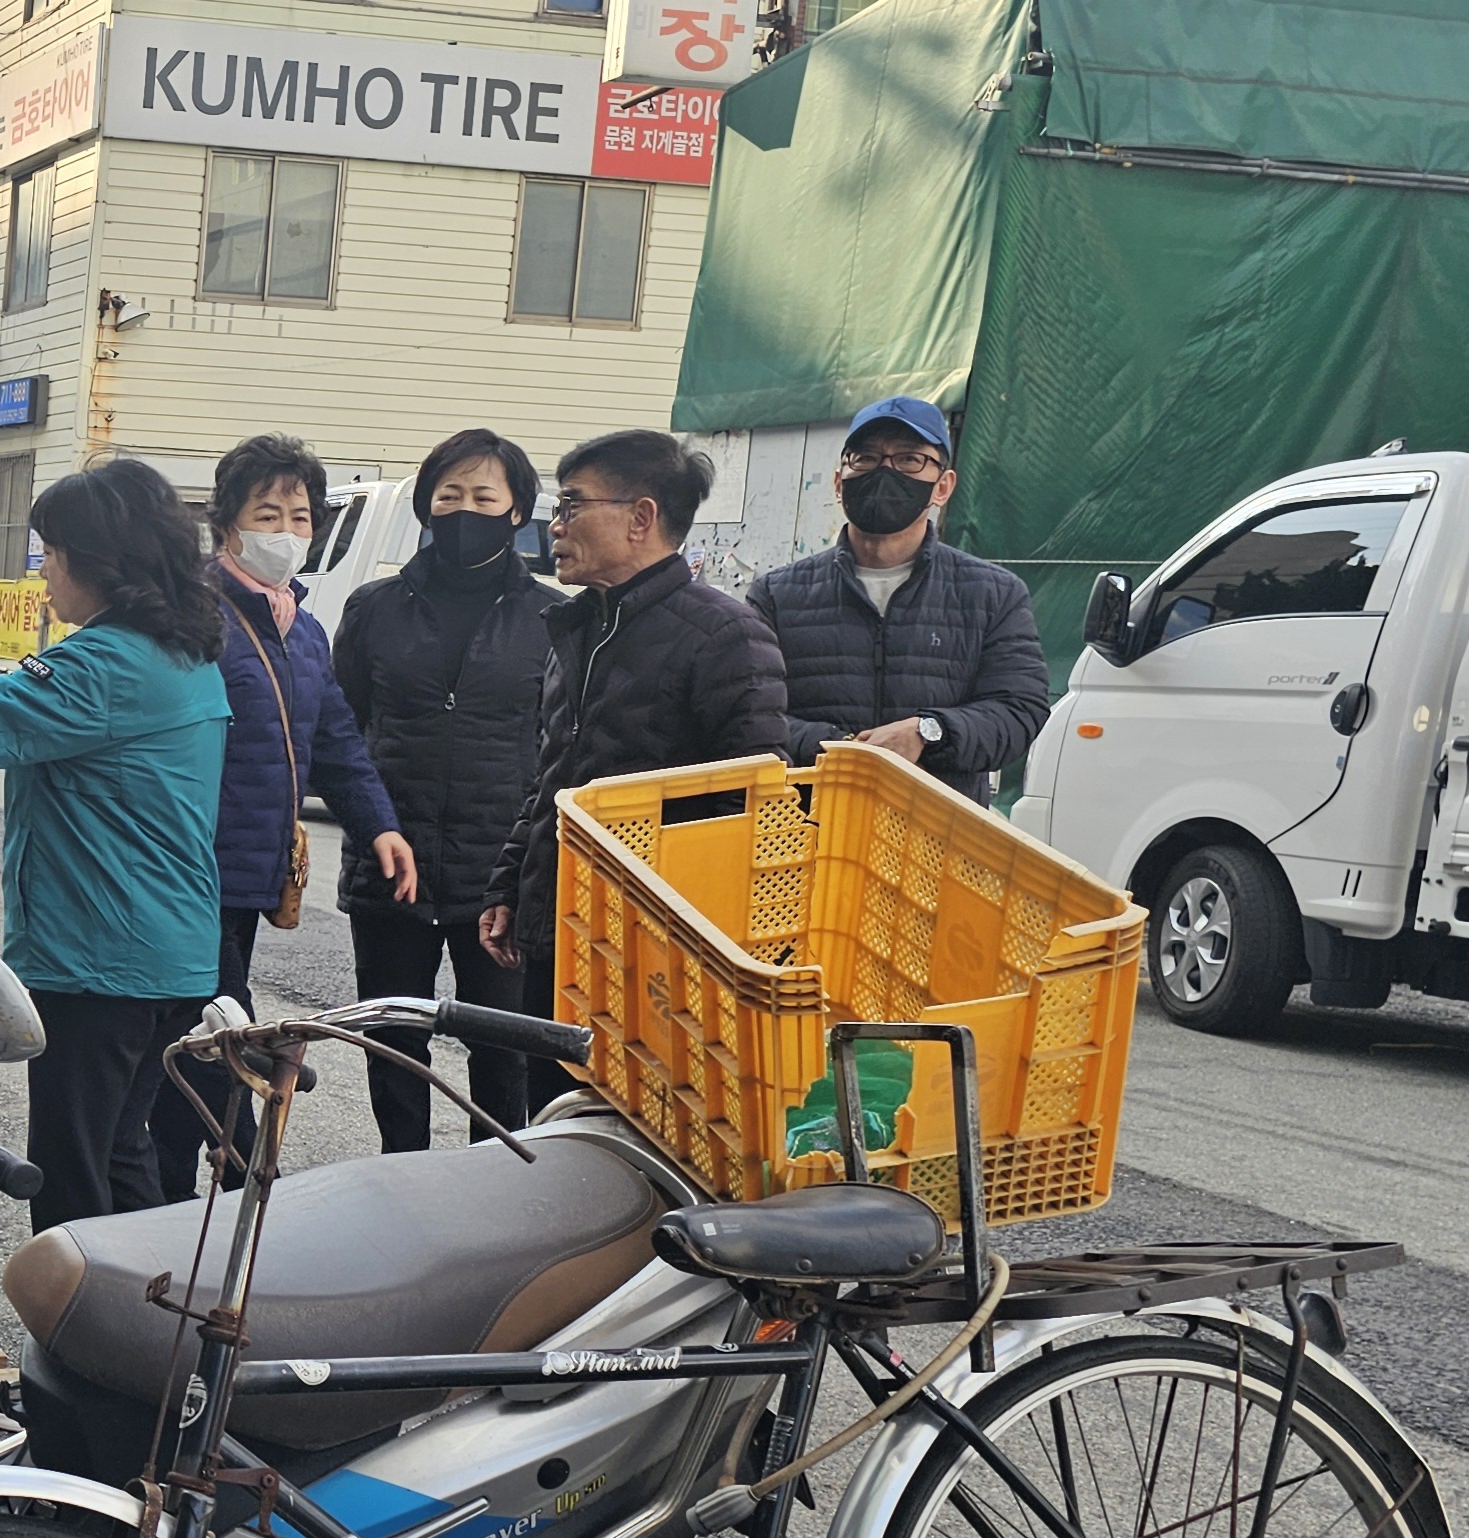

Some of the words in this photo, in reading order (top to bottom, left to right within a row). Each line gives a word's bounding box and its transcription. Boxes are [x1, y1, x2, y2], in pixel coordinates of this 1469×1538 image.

[659, 0, 746, 73] 장
[10, 60, 92, 146] 금호타이어
[142, 46, 404, 130] KUMHO
[420, 72, 564, 144] TIRE
[603, 125, 636, 152] 문현
[641, 128, 705, 158] 지게골점
[1267, 673, 1325, 686] porter
[569, 1345, 682, 1374] Stanard
[555, 1490, 580, 1515] Up
